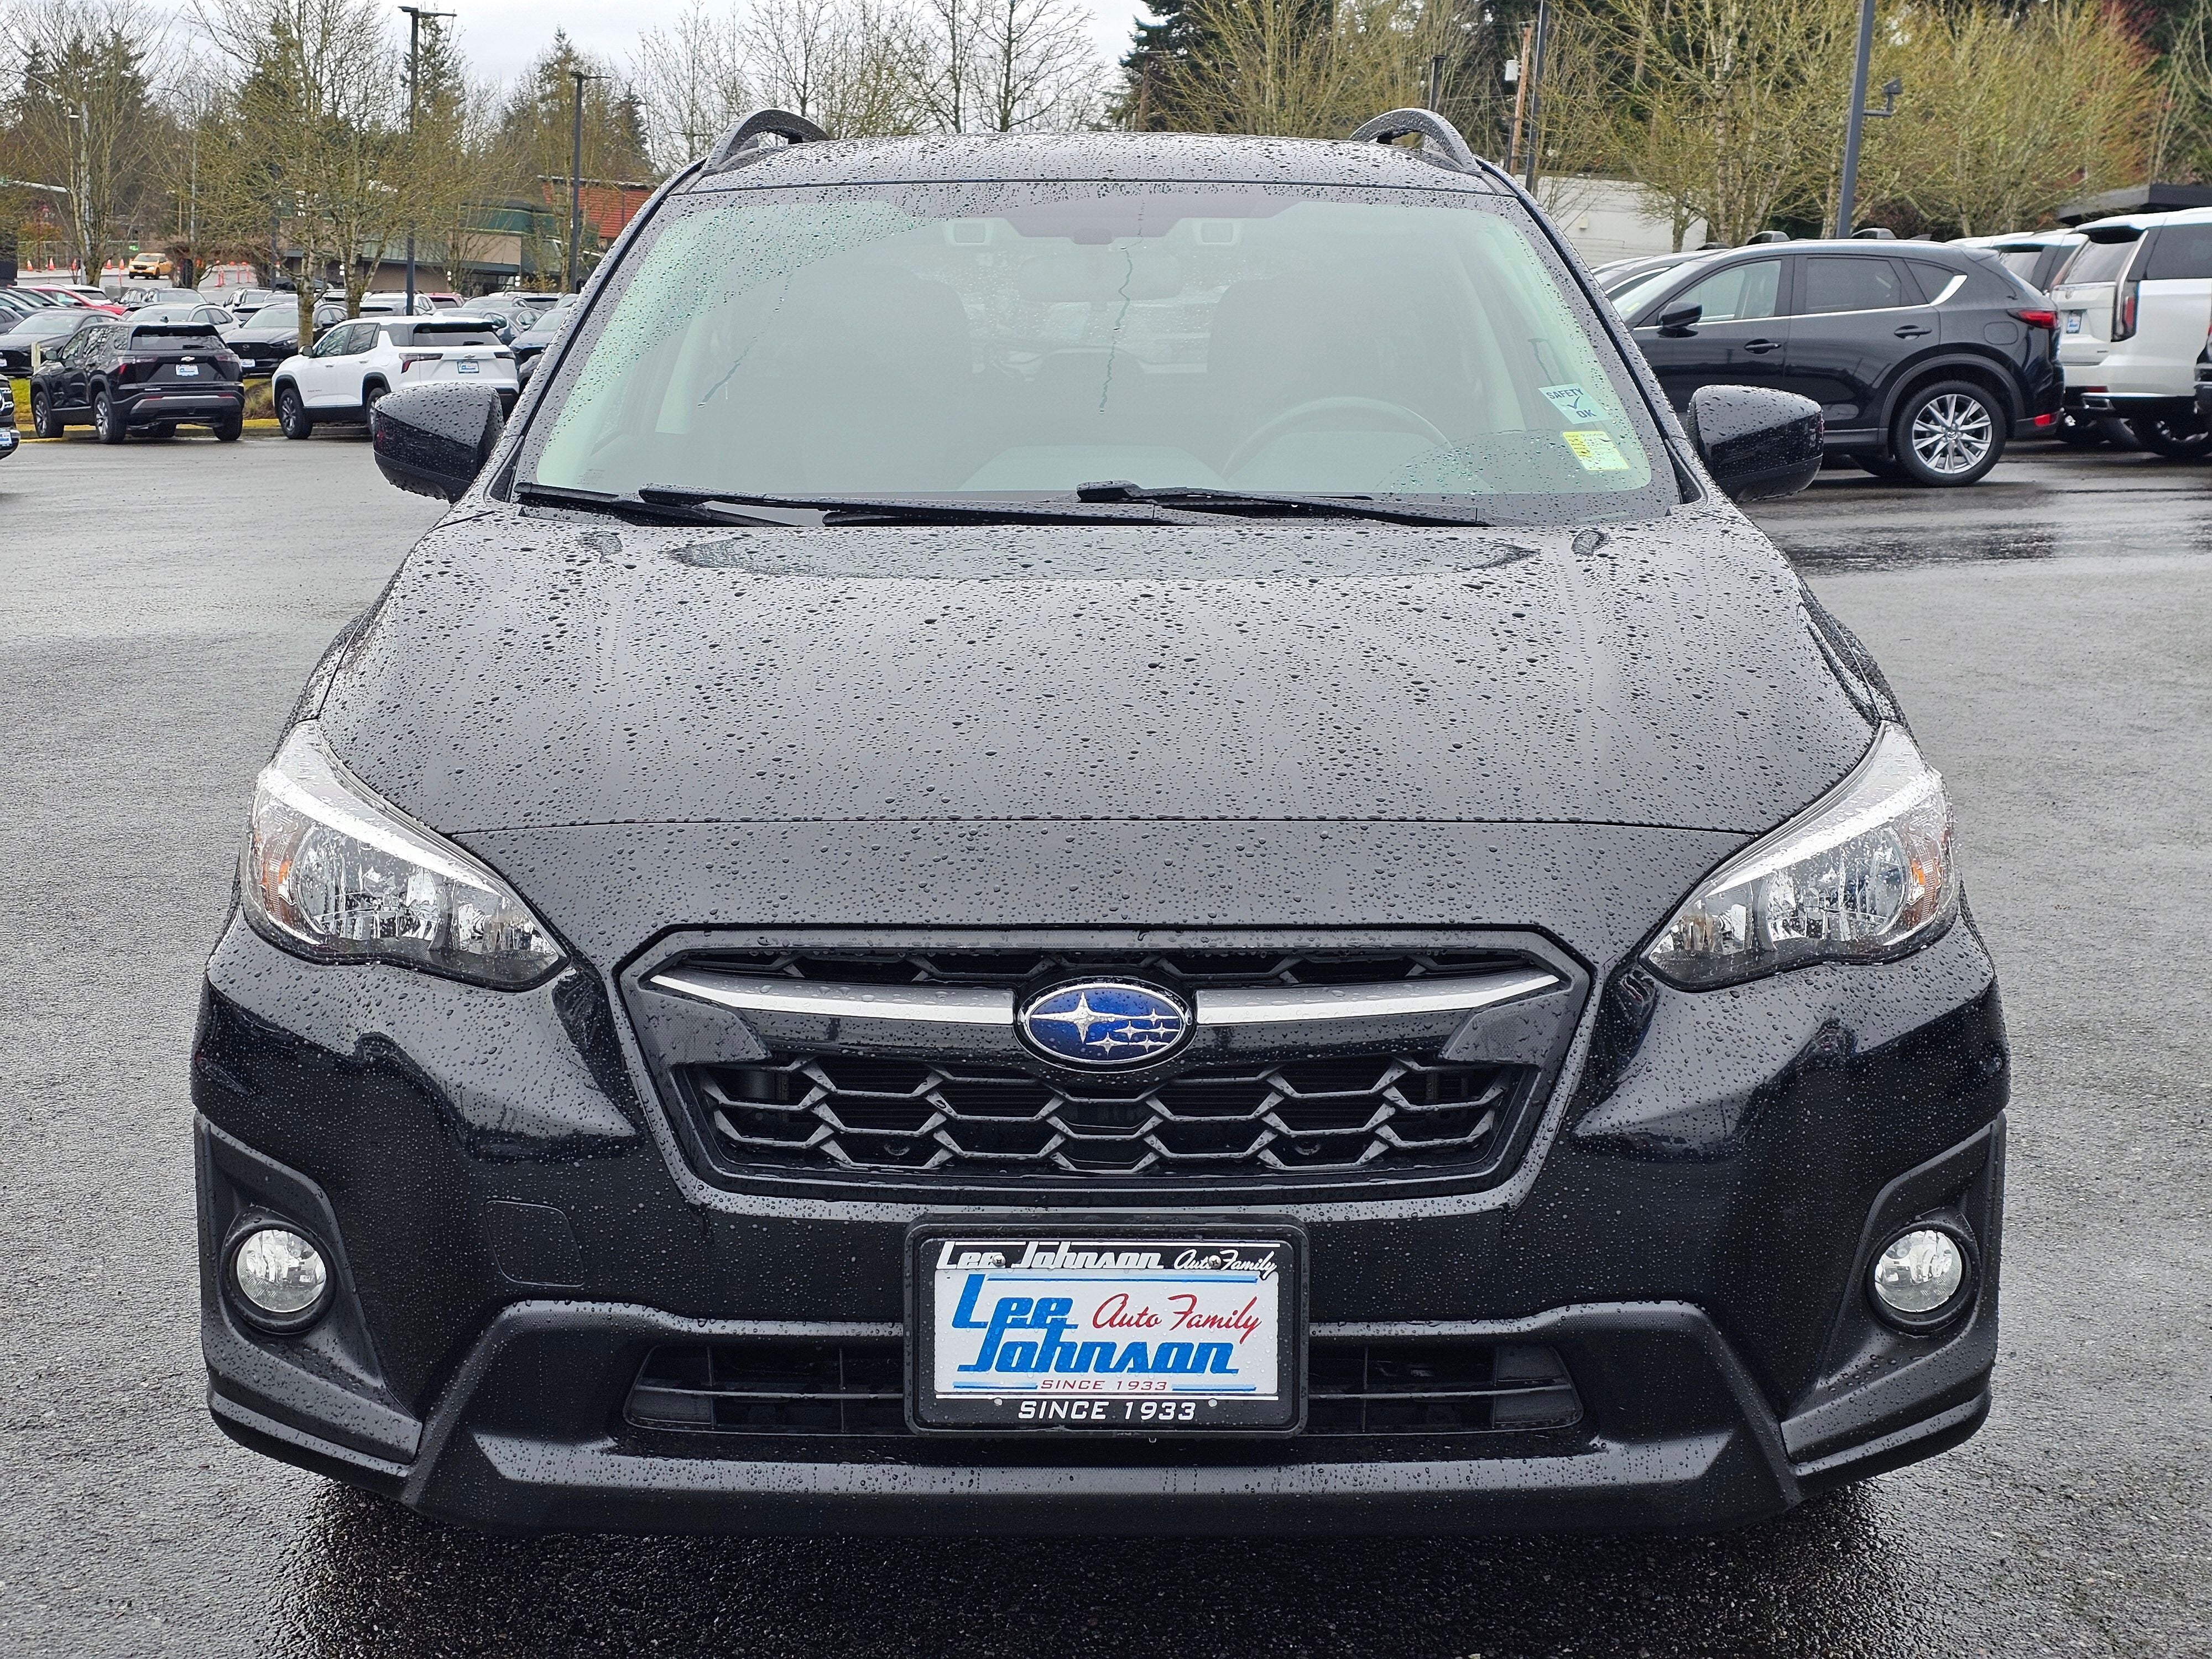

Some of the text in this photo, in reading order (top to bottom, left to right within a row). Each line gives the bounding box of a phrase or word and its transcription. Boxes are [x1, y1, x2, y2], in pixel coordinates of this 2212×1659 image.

[1546, 388, 1584, 400] SAFETY
[1576, 409, 1597, 419] OK
[936, 1241, 1277, 1280] Lee Johnson Aut Family
[952, 1274, 1262, 1344] Lee Auto Family
[957, 1311, 1240, 1374] Johnson
[1040, 1379, 1167, 1391] SINCE 1933
[1018, 1400, 1196, 1421] SINCE 1933
